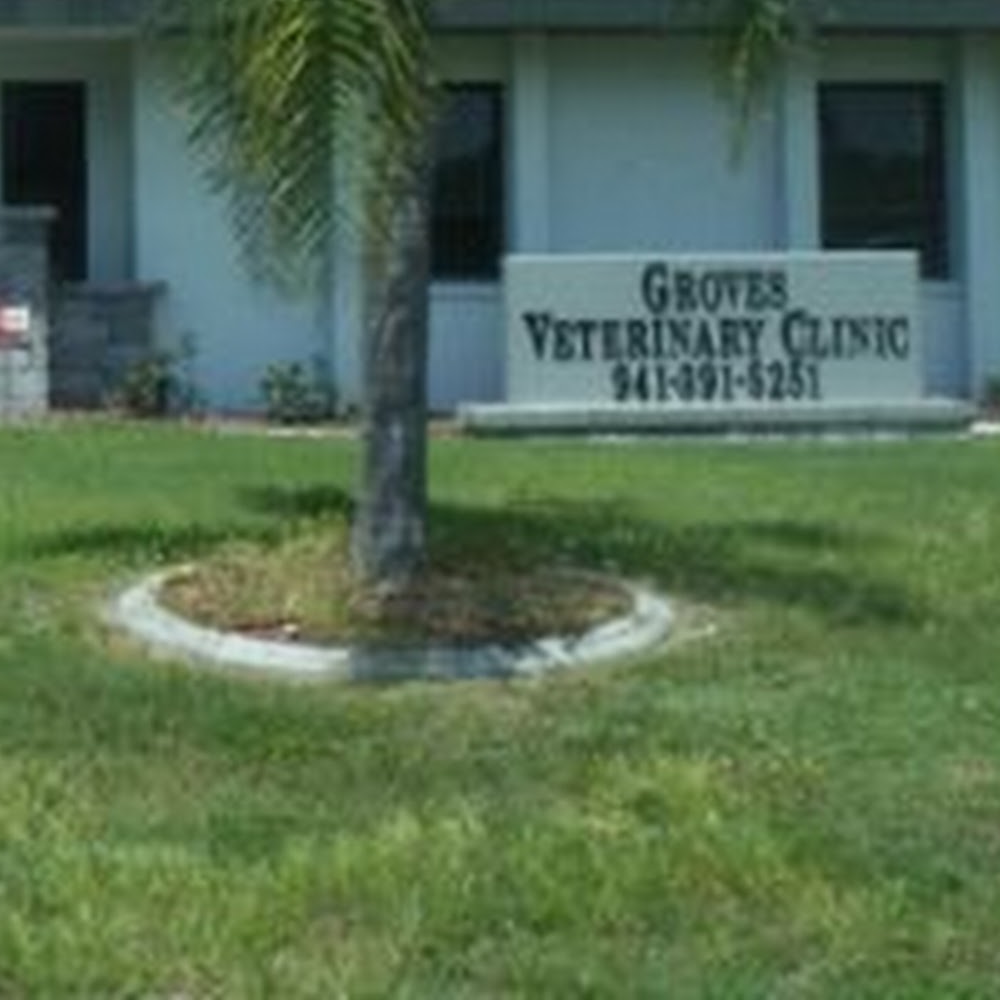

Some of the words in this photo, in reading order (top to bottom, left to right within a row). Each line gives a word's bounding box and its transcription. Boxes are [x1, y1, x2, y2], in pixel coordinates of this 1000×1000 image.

[642, 263, 787, 312] GROVES
[525, 311, 764, 360] VETERINARY
[780, 311, 909, 358] CLINIC
